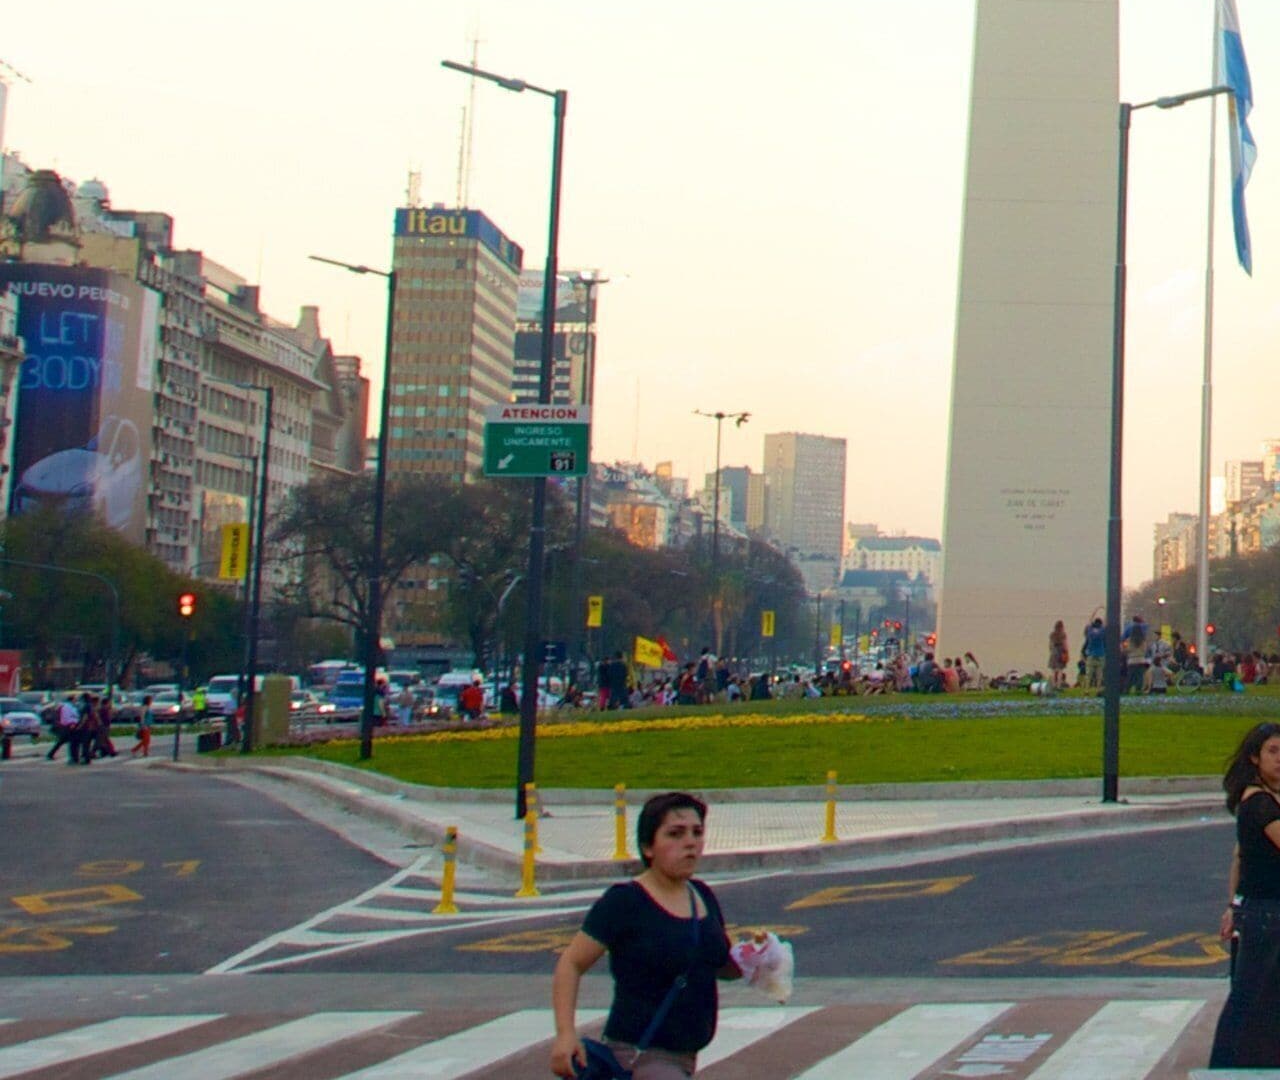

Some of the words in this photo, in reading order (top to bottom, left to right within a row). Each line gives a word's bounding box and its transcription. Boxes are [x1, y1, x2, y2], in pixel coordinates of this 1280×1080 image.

[8, 281, 75, 298] NUEVO
[40, 311, 98, 345] LET
[501, 407, 578, 419] ATENCION
[514, 427, 563, 436] INGRESO
[503, 438, 572, 447] UNICAMENTE
